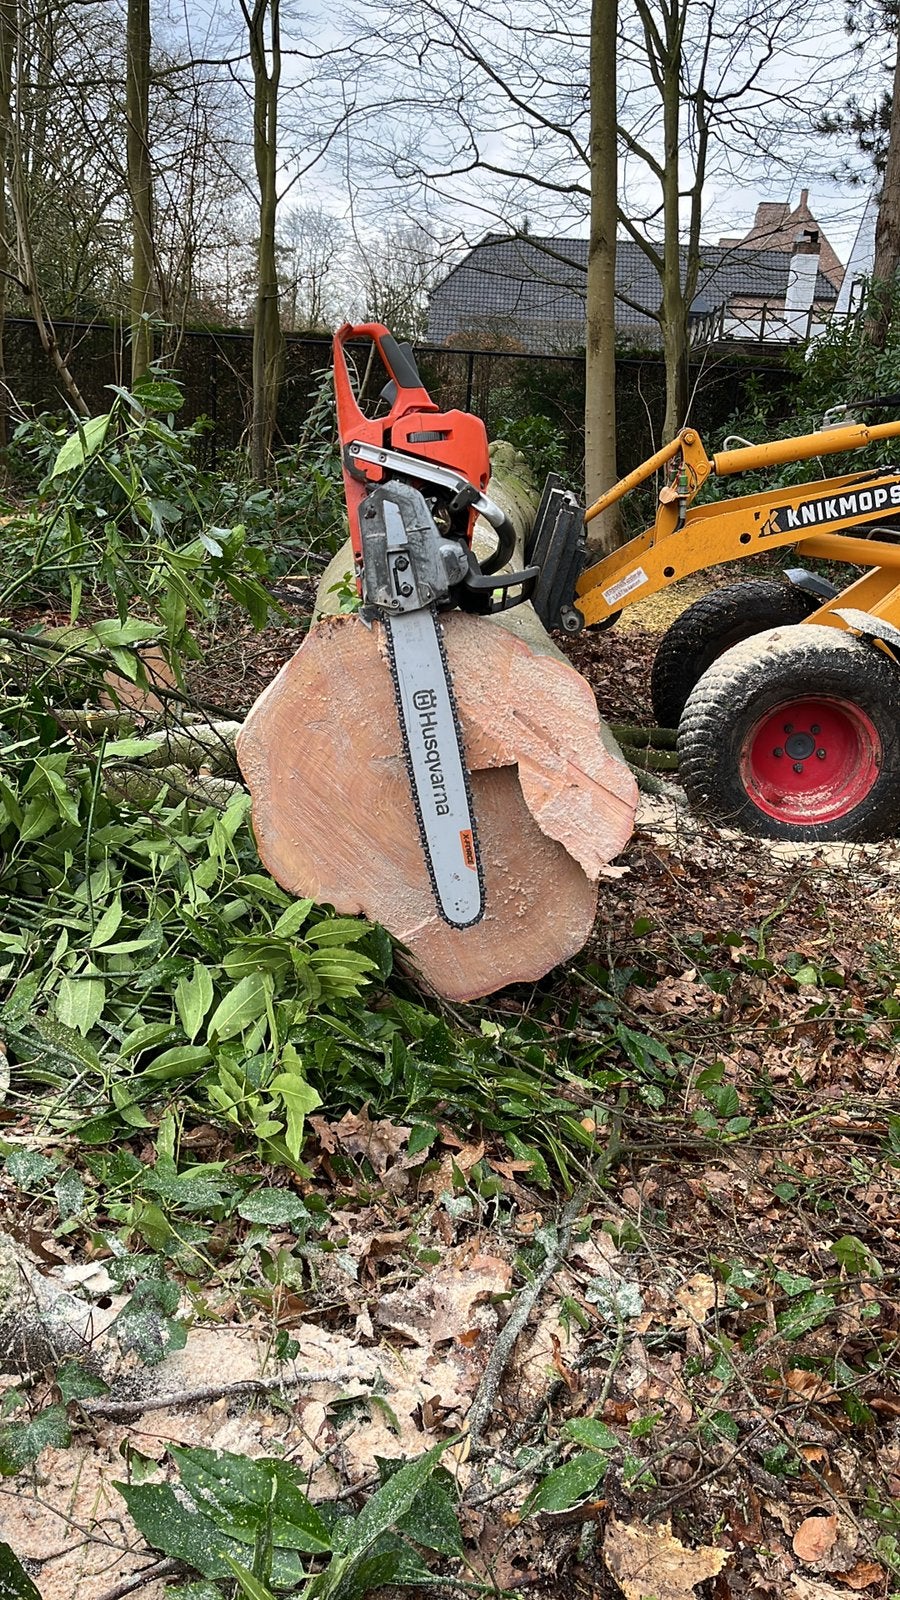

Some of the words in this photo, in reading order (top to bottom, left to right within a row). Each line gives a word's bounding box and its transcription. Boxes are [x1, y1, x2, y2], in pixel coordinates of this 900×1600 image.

[786, 485, 900, 528] KNIKMOPS
[419, 711, 450, 816] Husqvarna
[463, 833, 474, 865] X-FORCE
